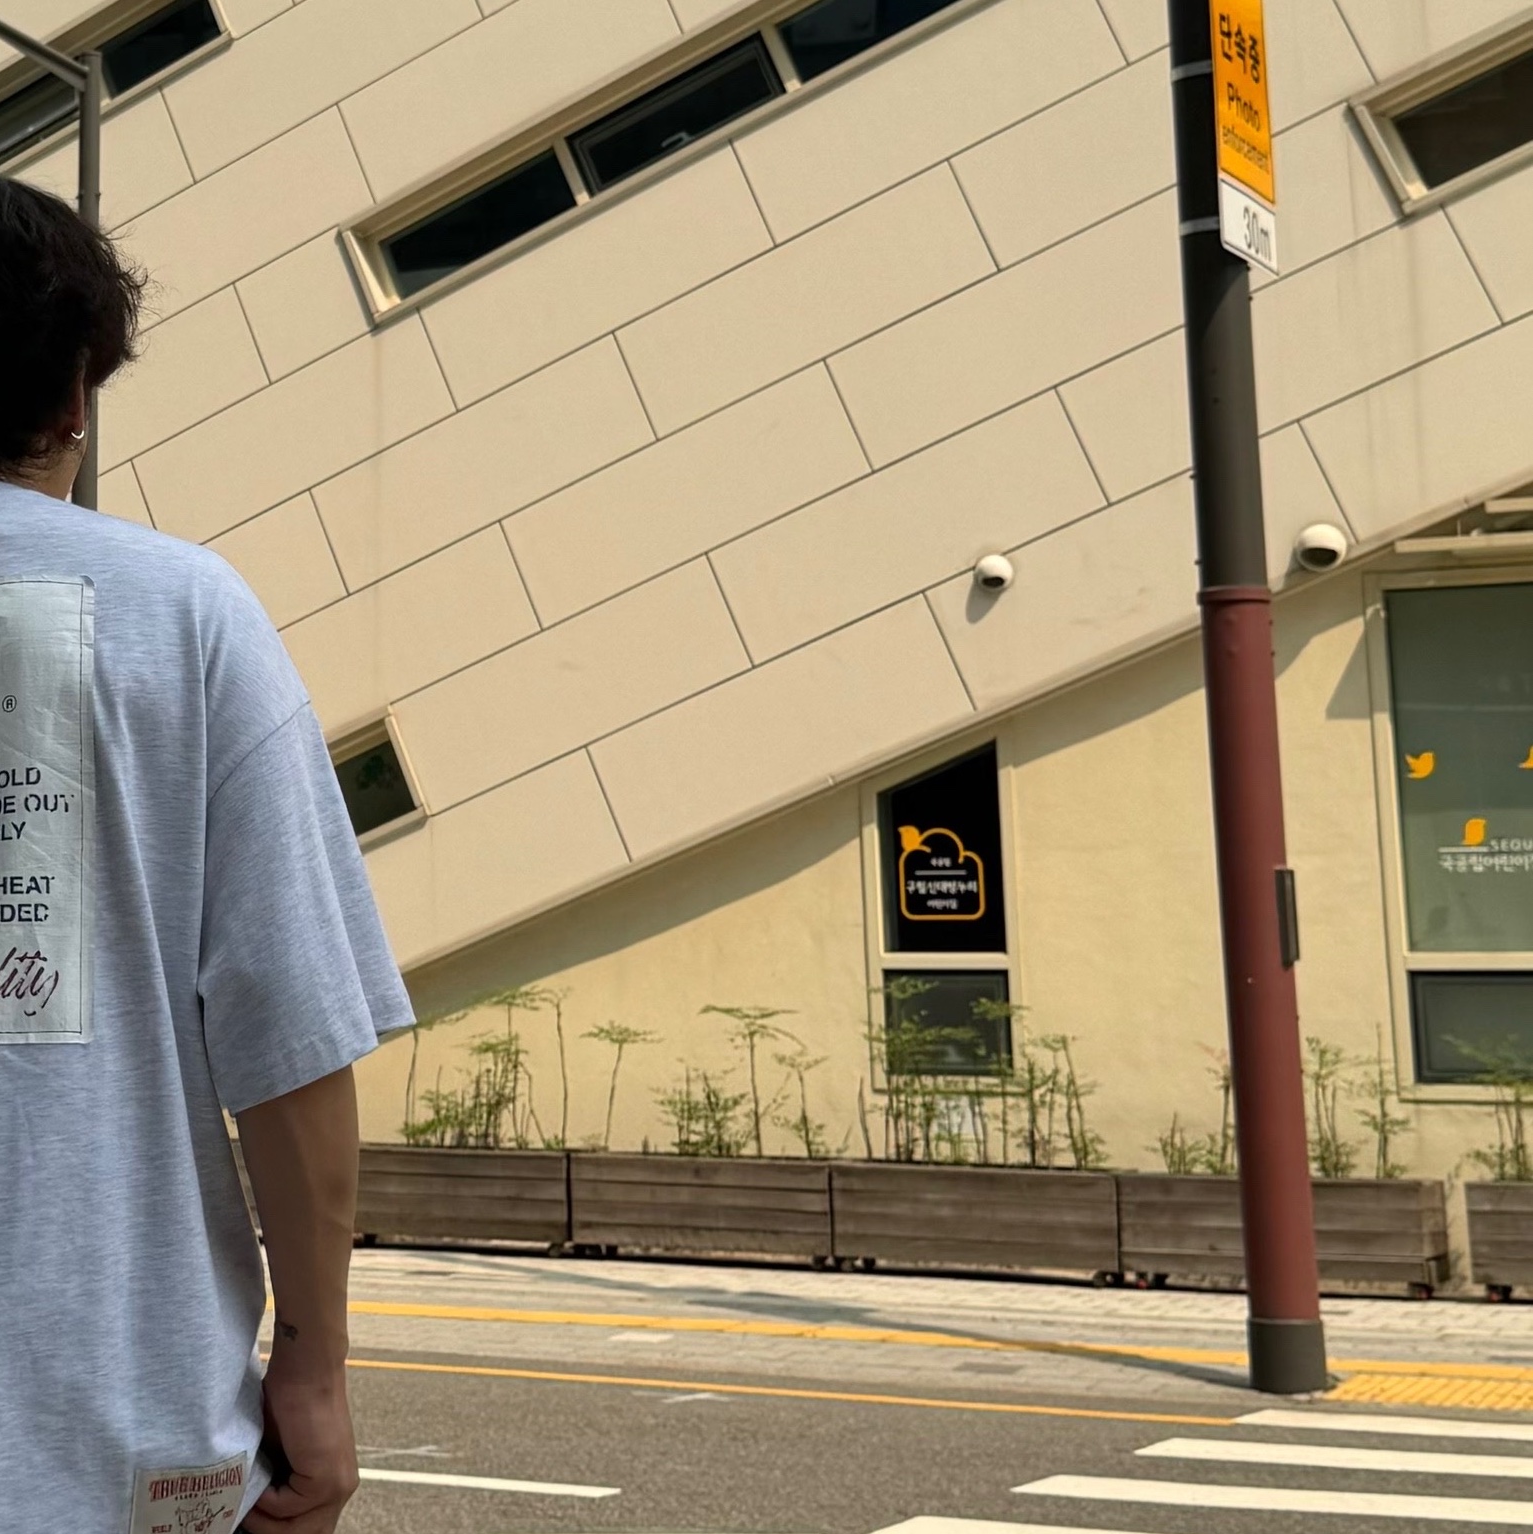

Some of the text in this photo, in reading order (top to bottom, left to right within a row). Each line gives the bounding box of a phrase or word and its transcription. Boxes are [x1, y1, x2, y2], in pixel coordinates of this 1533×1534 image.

[1219, 13, 1260, 84] 단속중
[1227, 82, 1261, 133] Photo
[1243, 206, 1272, 262] 30m
[24, 794, 75, 813] OUT
[1438, 853, 1533, 873] 국공립어린이
